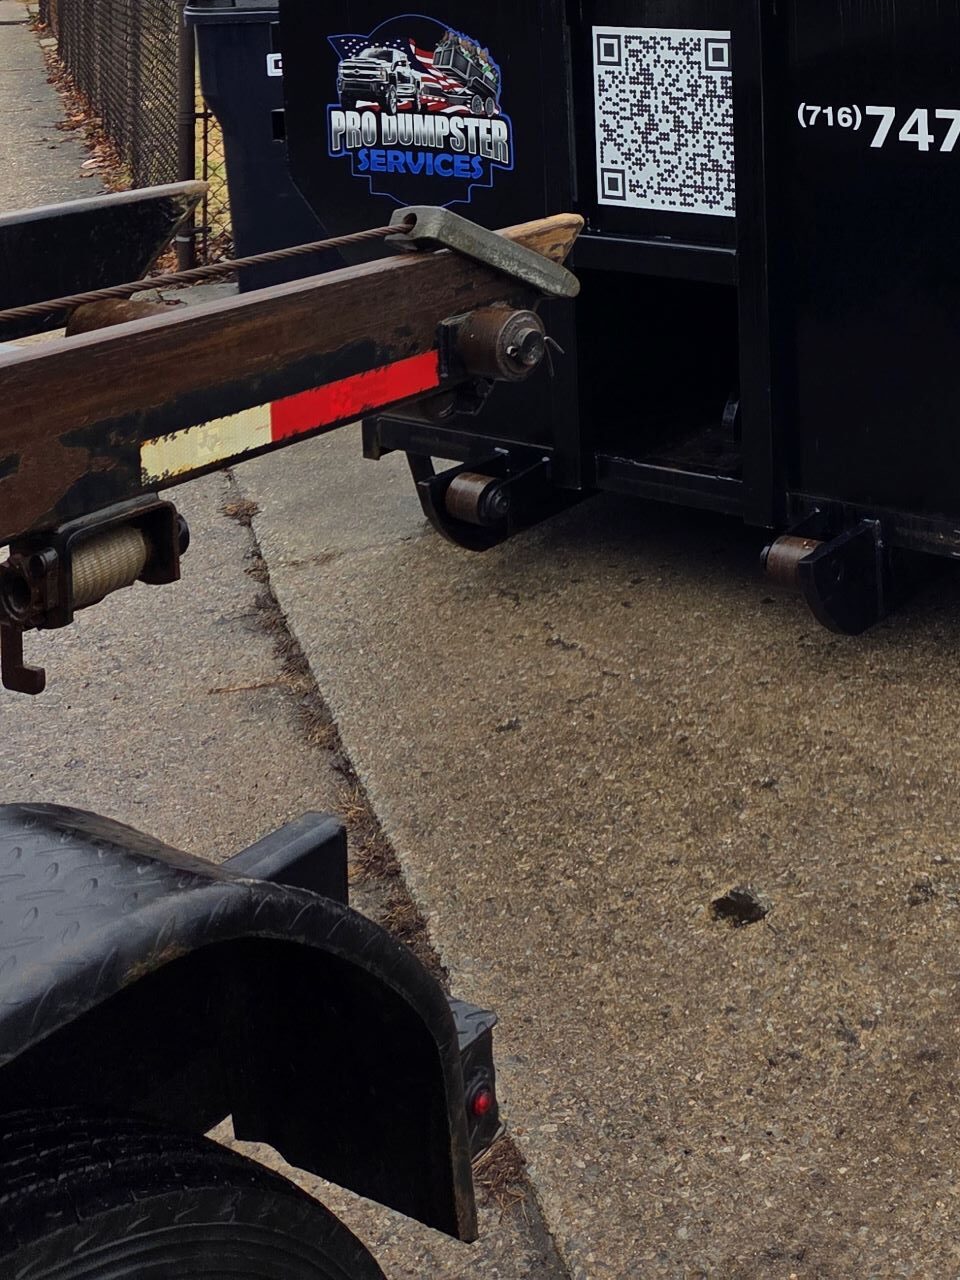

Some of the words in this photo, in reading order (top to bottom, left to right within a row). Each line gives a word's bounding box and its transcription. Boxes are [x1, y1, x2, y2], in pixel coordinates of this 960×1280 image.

[331, 110, 377, 151] PRO
[381, 112, 509, 164] DUMPSTER
[357, 148, 484, 180] SERVICES
